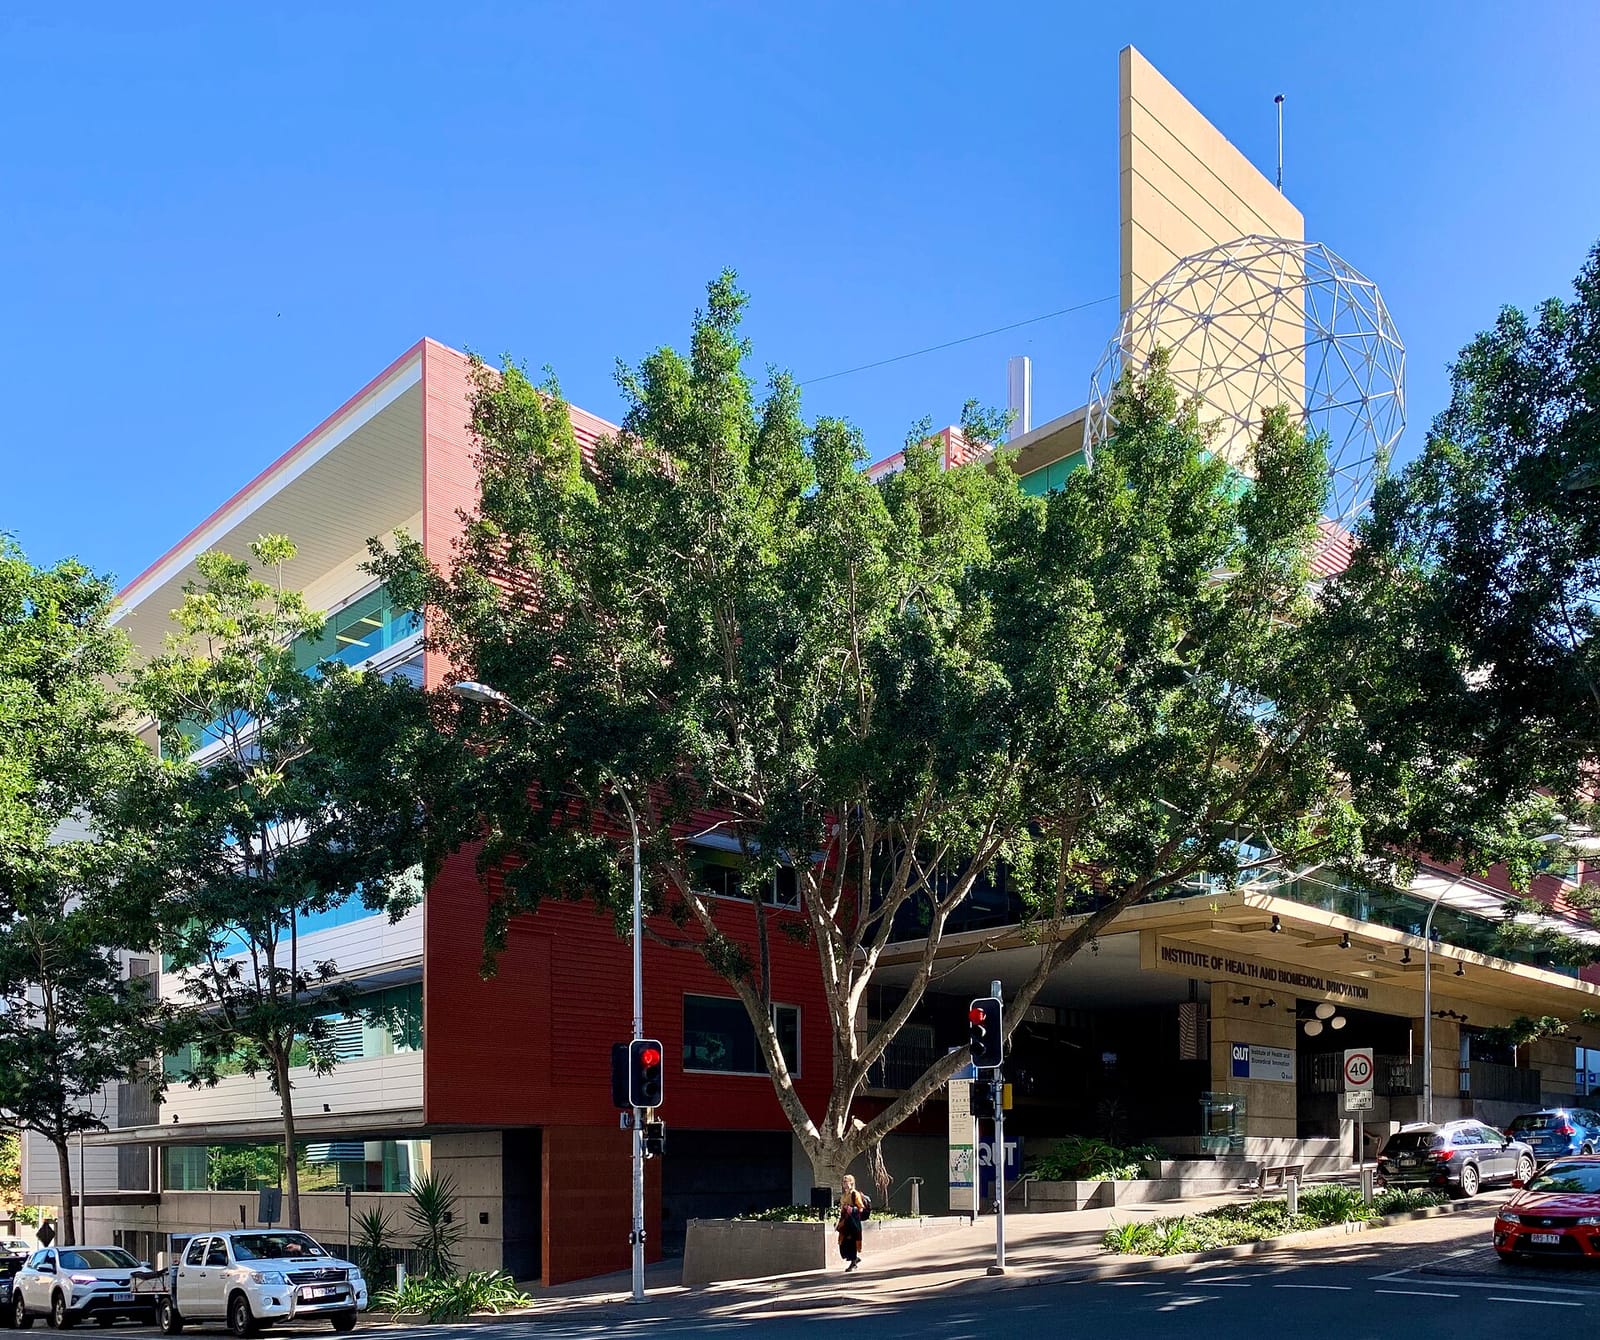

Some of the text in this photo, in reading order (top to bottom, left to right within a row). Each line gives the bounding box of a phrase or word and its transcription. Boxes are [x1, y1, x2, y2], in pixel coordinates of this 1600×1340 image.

[1161, 946, 1369, 999] INSTITUTE OF HEALTH AND BIOMEDICAL INNOVATION
[1233, 1046, 1249, 1061] QUT
[1350, 1062, 1368, 1076] 40
